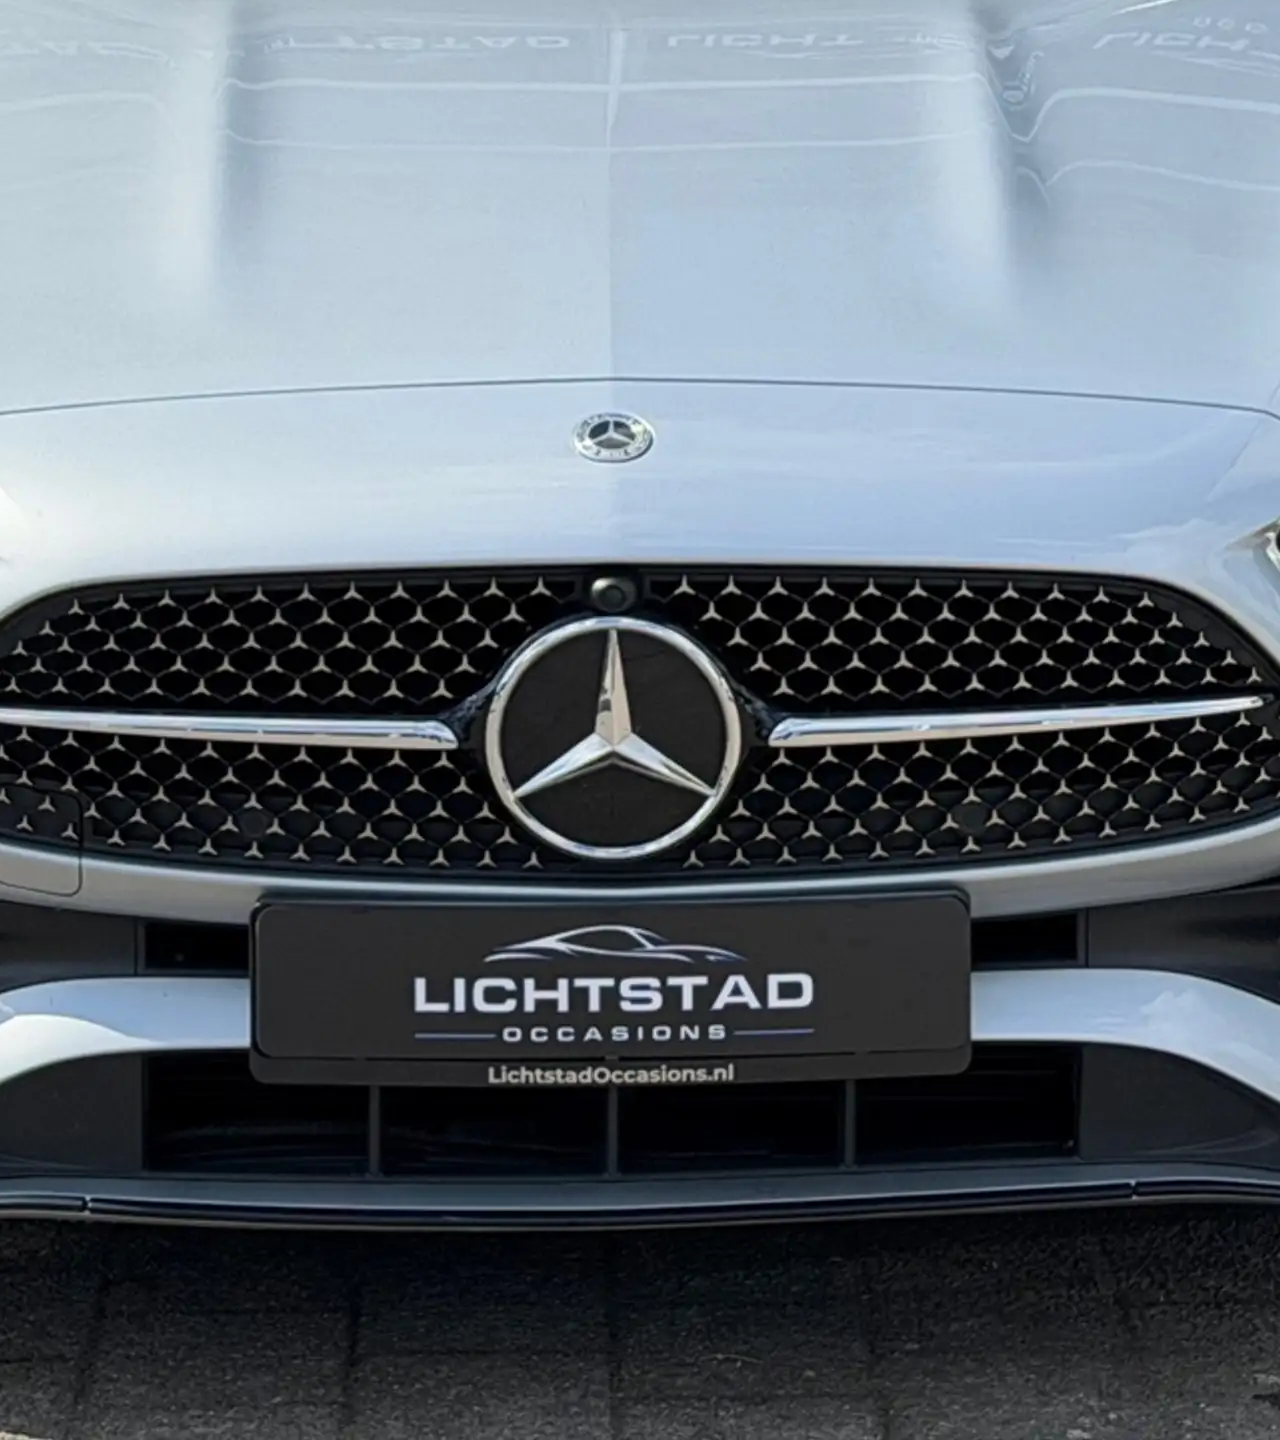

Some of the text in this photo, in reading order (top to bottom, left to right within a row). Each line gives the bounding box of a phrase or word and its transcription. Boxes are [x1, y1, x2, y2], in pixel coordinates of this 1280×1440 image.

[414, 972, 814, 1013] LICHTSTAD
[502, 1023, 727, 1043] OCCASIONS
[487, 1063, 735, 1085] LichtstadOccasions.nl
